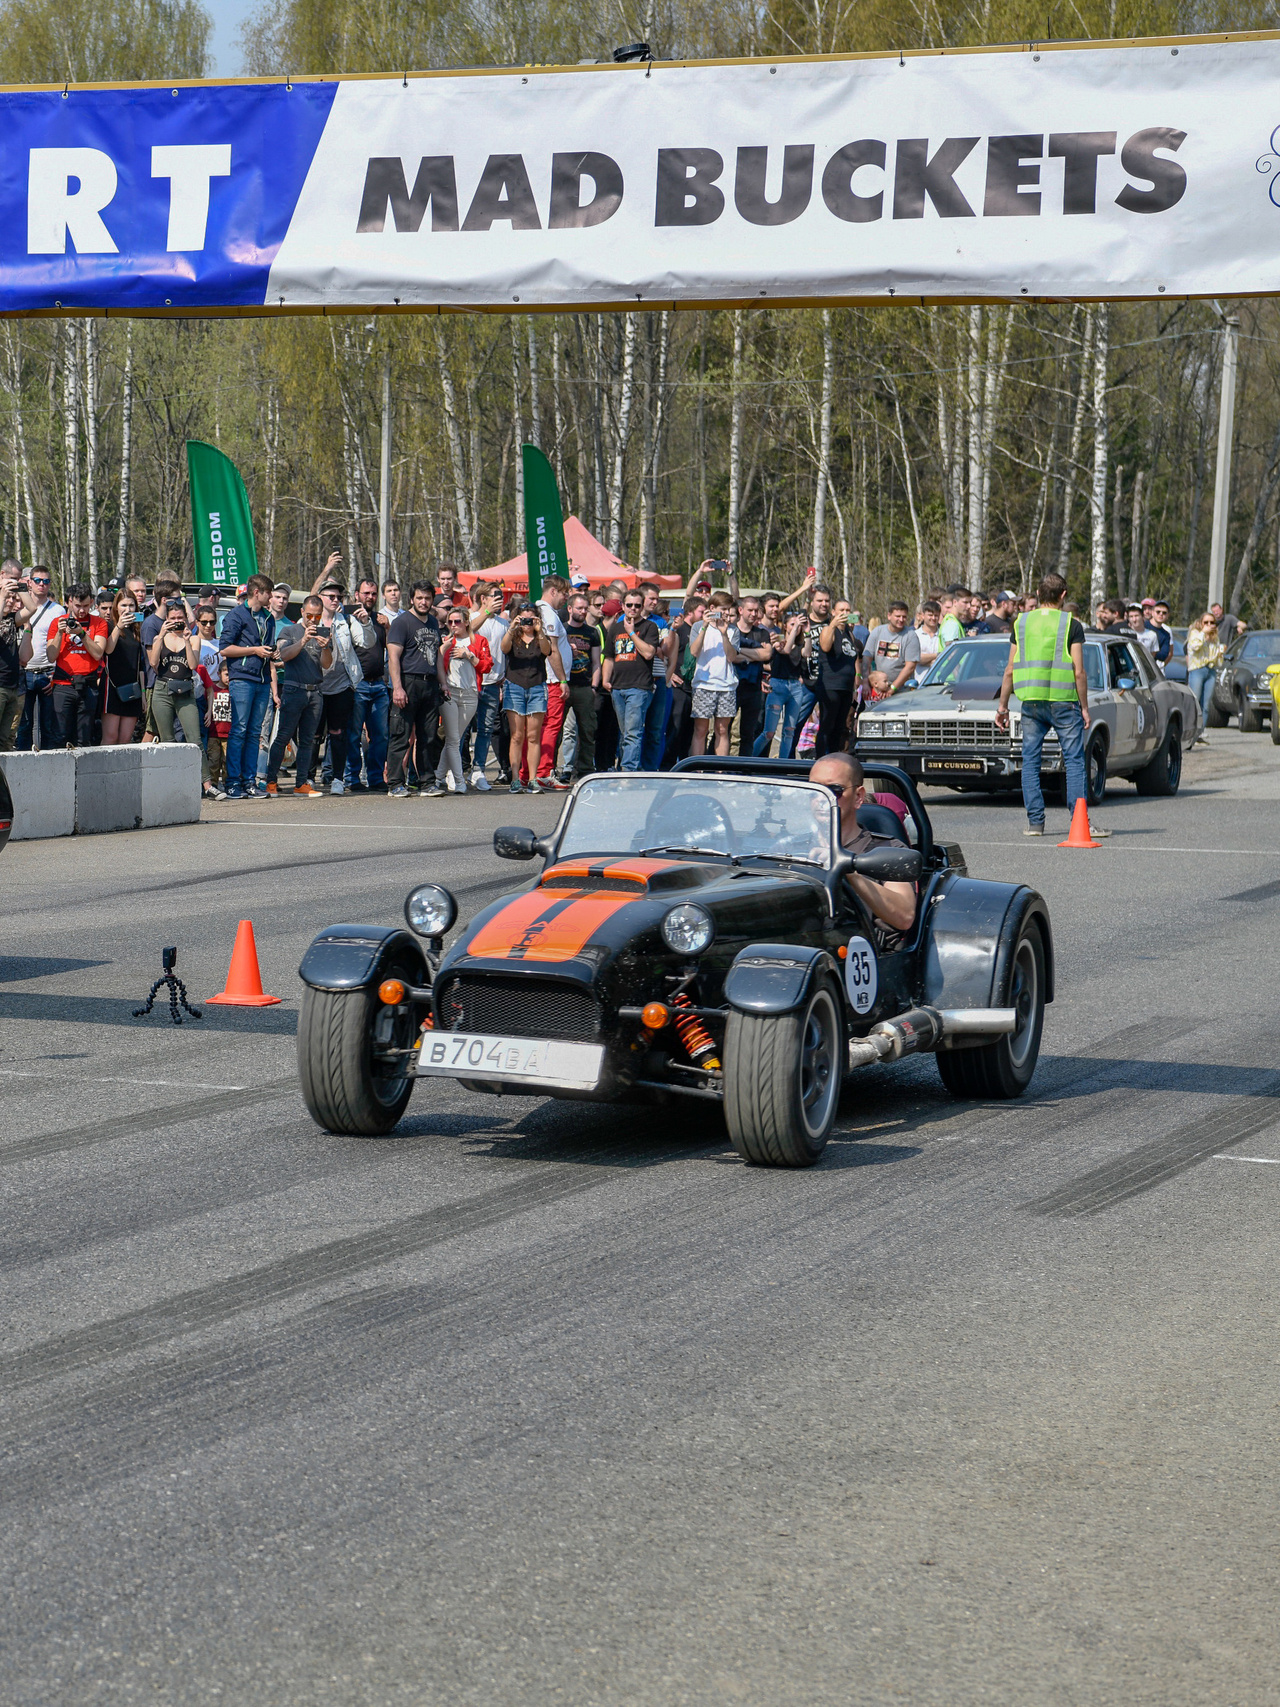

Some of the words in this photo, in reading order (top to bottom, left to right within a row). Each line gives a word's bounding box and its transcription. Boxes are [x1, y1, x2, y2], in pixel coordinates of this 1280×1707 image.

[356, 151, 625, 233] MAD
[655, 126, 1188, 227] BUCKETS
[209, 512, 226, 584] EEDOM
[944, 762, 981, 770] CUSTOMS
[580, 787, 596, 808] 2
[852, 951, 871, 986] 35
